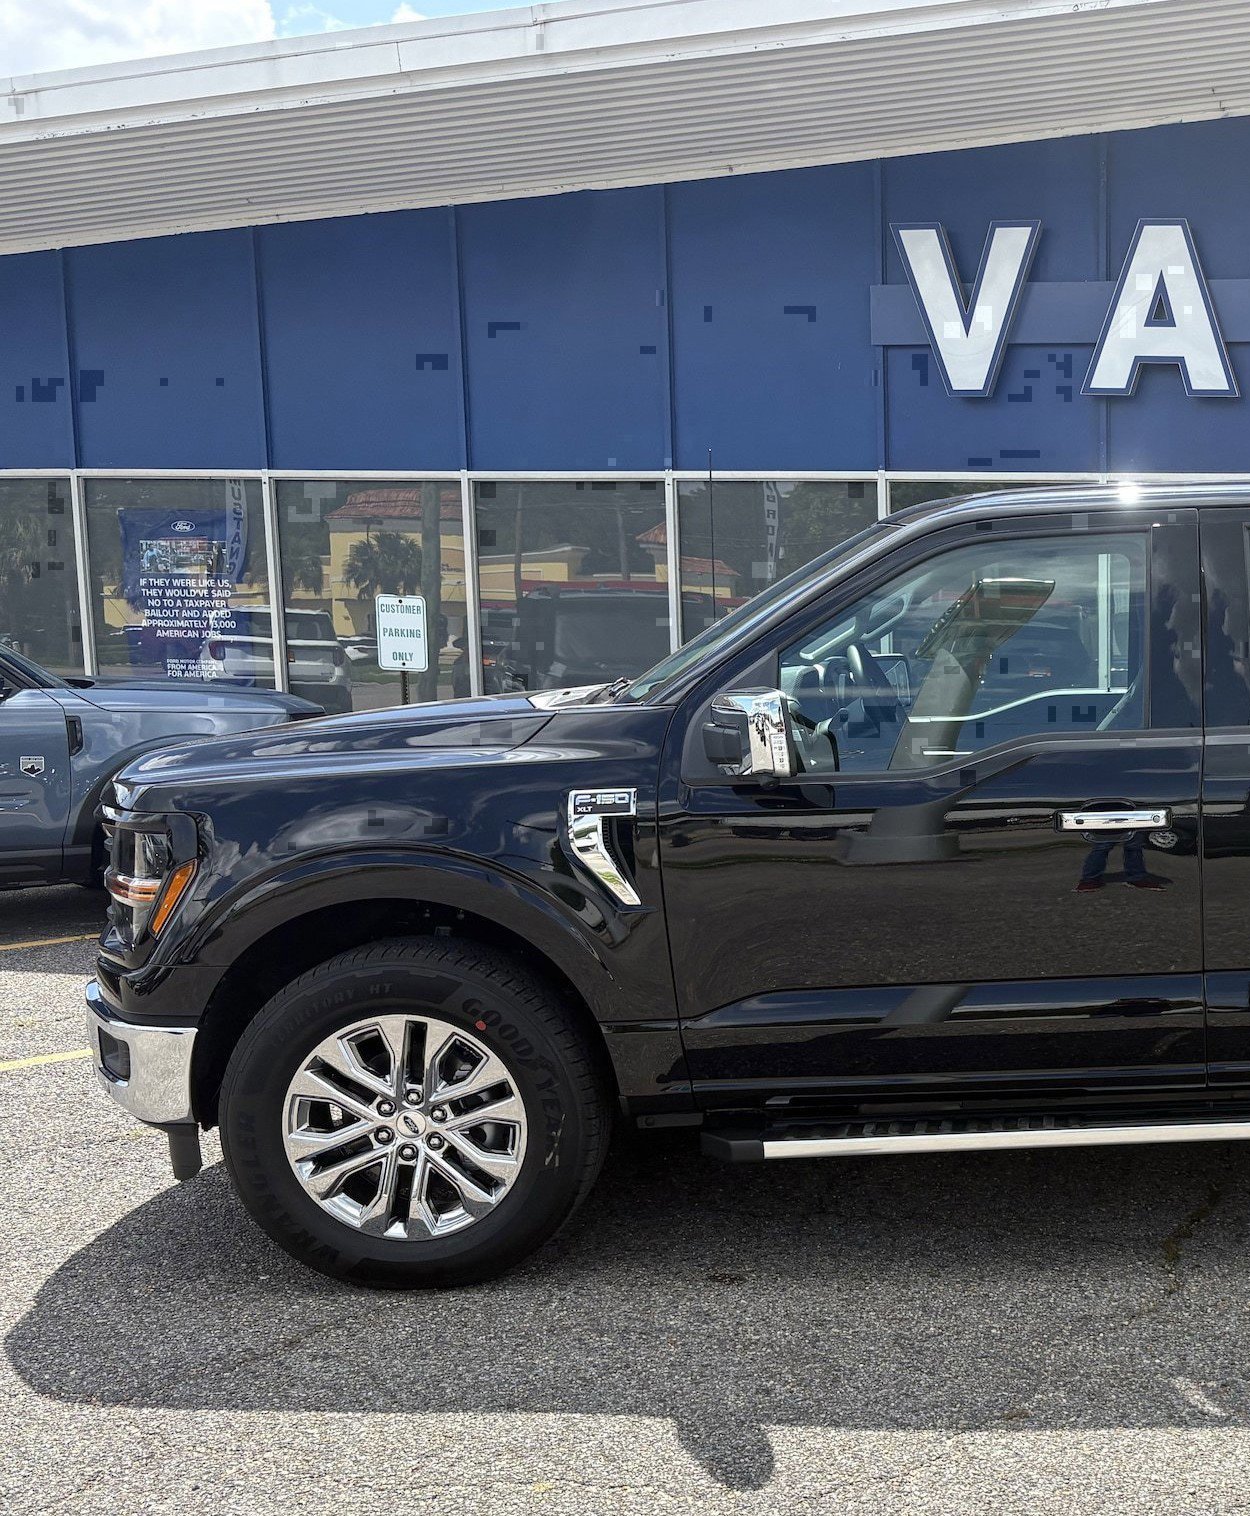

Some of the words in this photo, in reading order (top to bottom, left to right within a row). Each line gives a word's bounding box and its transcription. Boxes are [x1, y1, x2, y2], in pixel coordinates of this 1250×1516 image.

[140, 578, 147, 586] IF
[148, 578, 171, 587] THEY
[172, 579, 196, 587] WERE
[198, 579, 215, 587] LIKE
[217, 579, 232, 589] US,
[142, 588, 163, 597] THEY
[165, 589, 209, 598] WOULD'VE
[211, 589, 231, 598] SAID
[148, 599, 160, 607] NO
[162, 599, 174, 607] TO
[176, 599, 182, 607] A
[184, 599, 227, 608] TAXPAYER
[380, 603, 421, 614] CUSTOMER
[144, 609, 179, 618] BAILOUT
[182, 609, 200, 618] AND
[202, 610, 231, 619] ADDED
[142, 619, 208, 628] APPROXIMATELY
[211, 620, 236, 629] 13,000
[156, 629, 199, 638] AMERICAN
[383, 627, 421, 638] PARKING
[392, 651, 414, 661] ONLY
[576, 794, 629, 805] F-150
